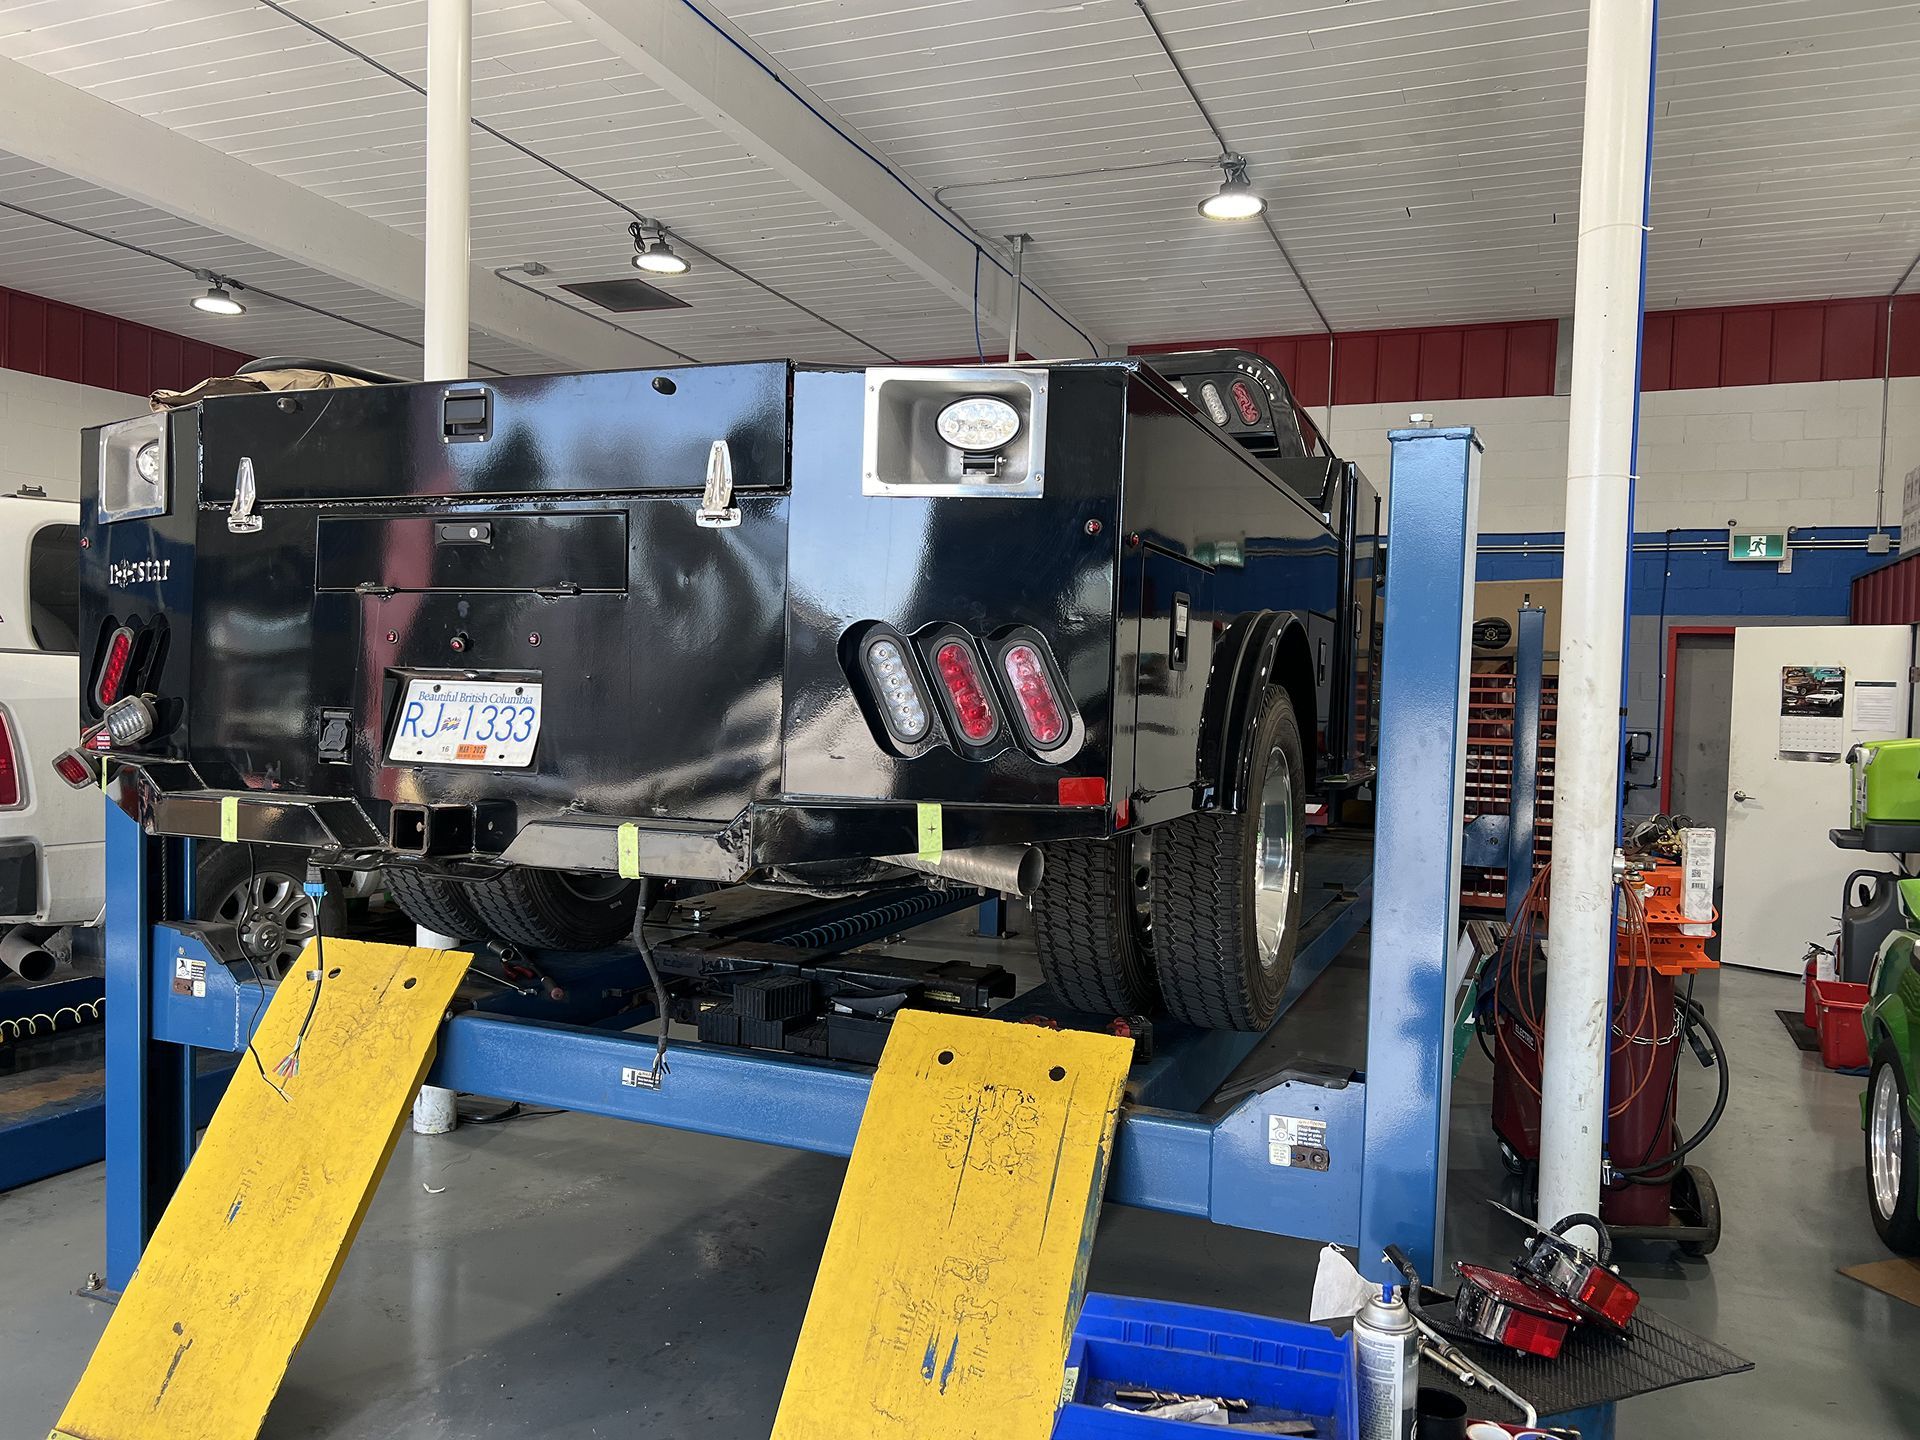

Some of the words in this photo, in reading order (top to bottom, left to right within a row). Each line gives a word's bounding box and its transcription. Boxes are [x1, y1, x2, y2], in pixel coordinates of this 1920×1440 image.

[418, 691, 458, 702] Beautiful
[460, 692, 488, 704] British
[489, 693, 534, 705] Columbia
[401, 701, 445, 738] RJ
[463, 704, 536, 743] 1333
